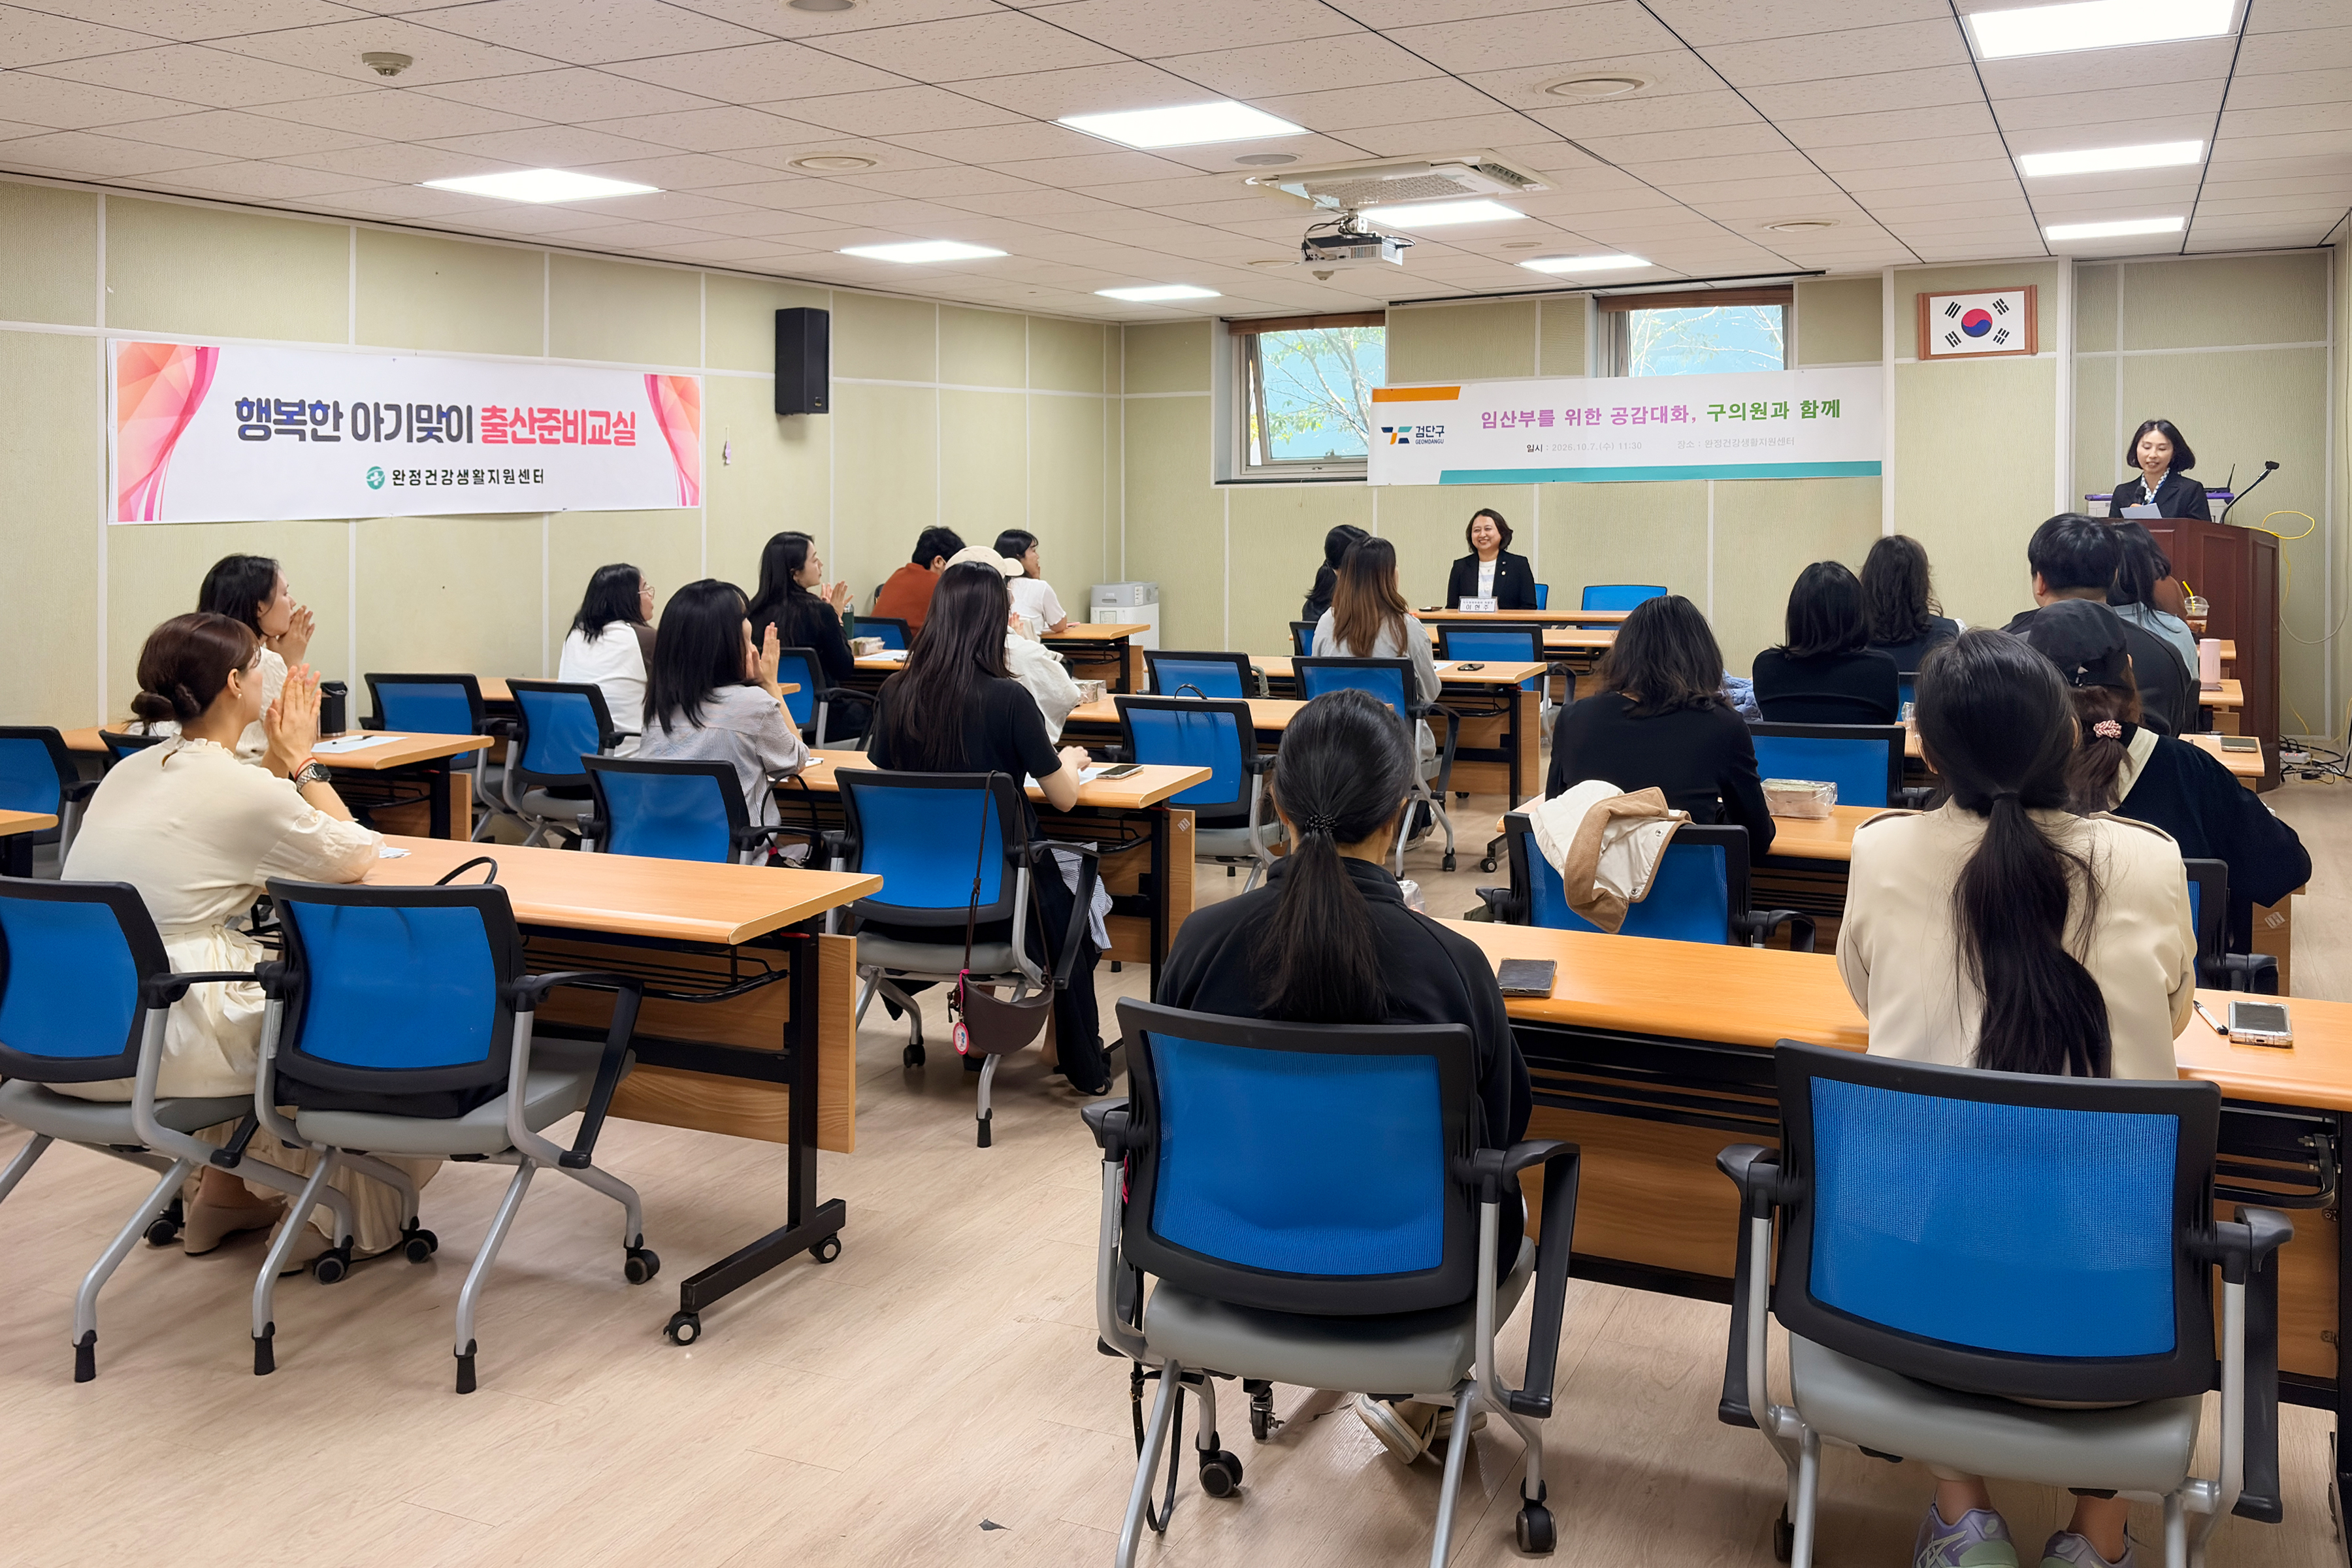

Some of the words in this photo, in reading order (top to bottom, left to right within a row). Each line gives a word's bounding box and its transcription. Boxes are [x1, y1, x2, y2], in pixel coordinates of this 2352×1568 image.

[235, 397, 344, 442] 행복한
[351, 402, 472, 444] 아기맞이
[480, 405, 636, 446] 출산준비교실
[1481, 409, 1556, 429] 임산부를
[1565, 408, 1602, 427] 위한
[1610, 404, 1696, 425] 공감대화,
[1707, 400, 1790, 423] 구의원과
[1800, 399, 1840, 419] 함께
[1415, 425, 1445, 438] 검단구
[1526, 444, 1543, 453] 일시
[1677, 440, 1695, 449] 장소
[1705, 437, 1795, 448] 완정건강생활지원센터
[392, 468, 544, 486] 완정건강생활지원센터
